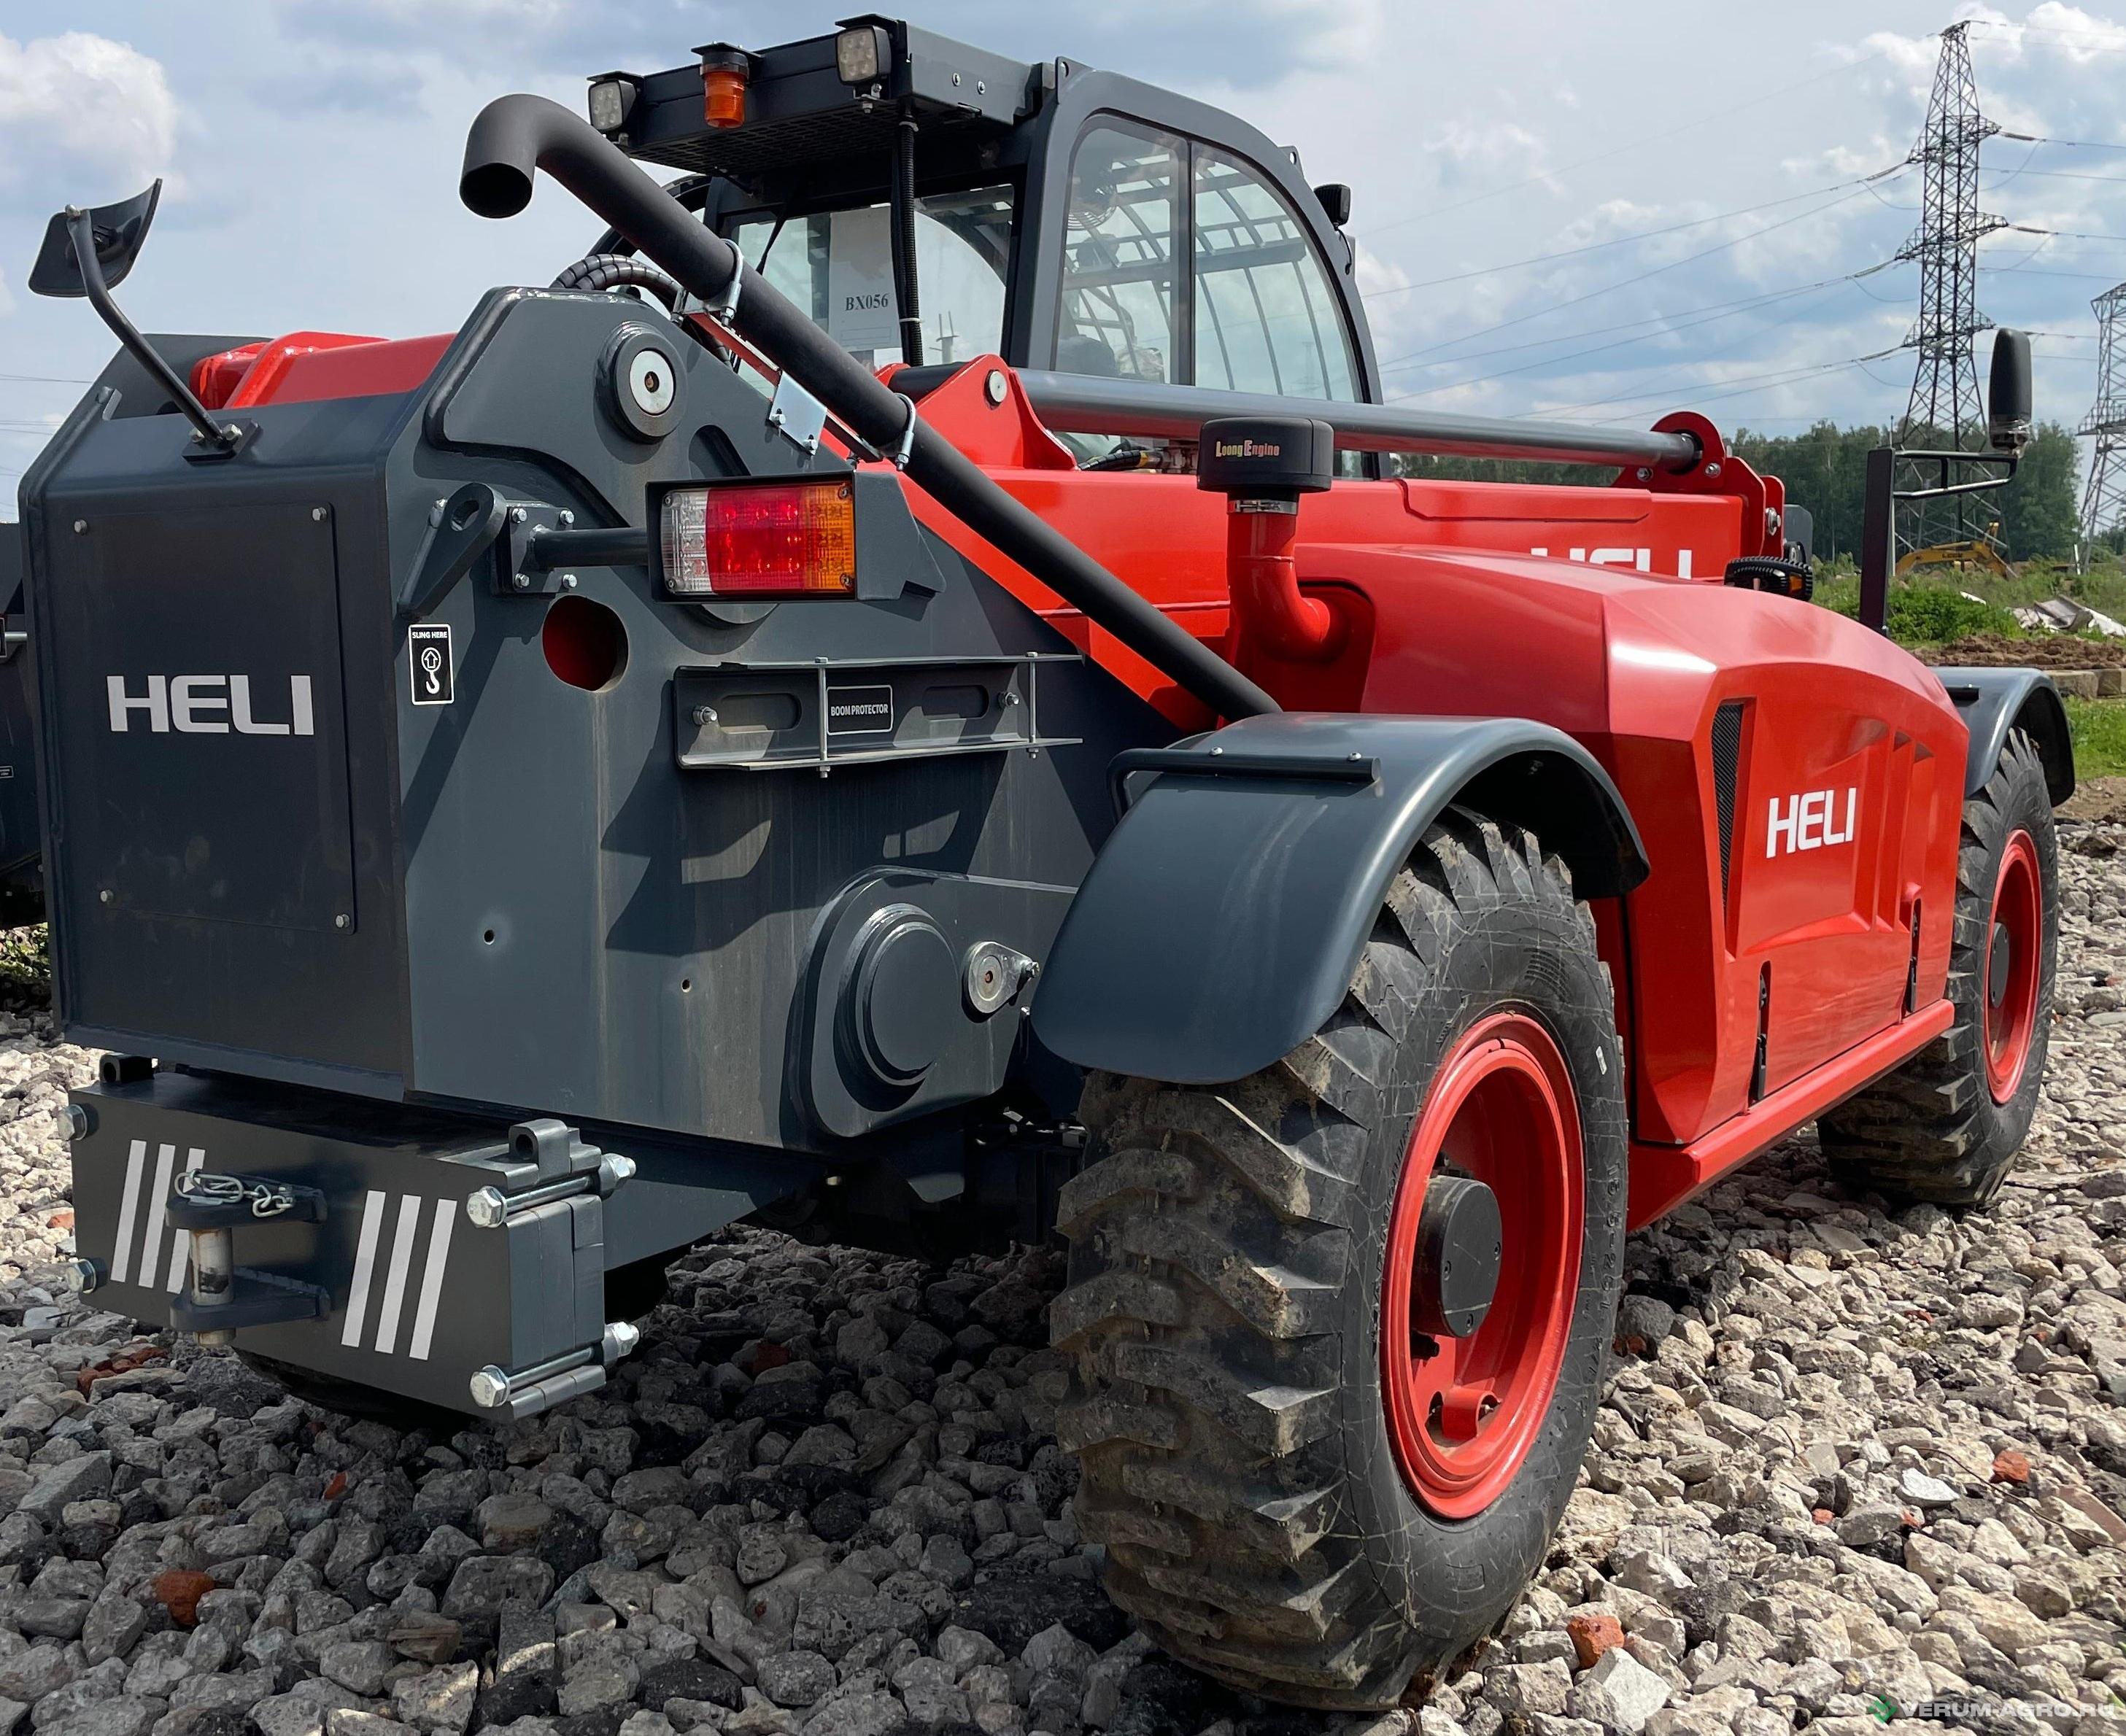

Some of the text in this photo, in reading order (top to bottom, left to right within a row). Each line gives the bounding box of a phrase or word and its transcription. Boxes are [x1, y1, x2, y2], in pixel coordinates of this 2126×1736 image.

[845, 292, 889, 311] BX056
[411, 631, 448, 639] SLING HERE
[106, 674, 315, 736] HELI
[830, 703, 889, 716] BOOM PROTECTOR
[1766, 786, 1857, 859] HELI
